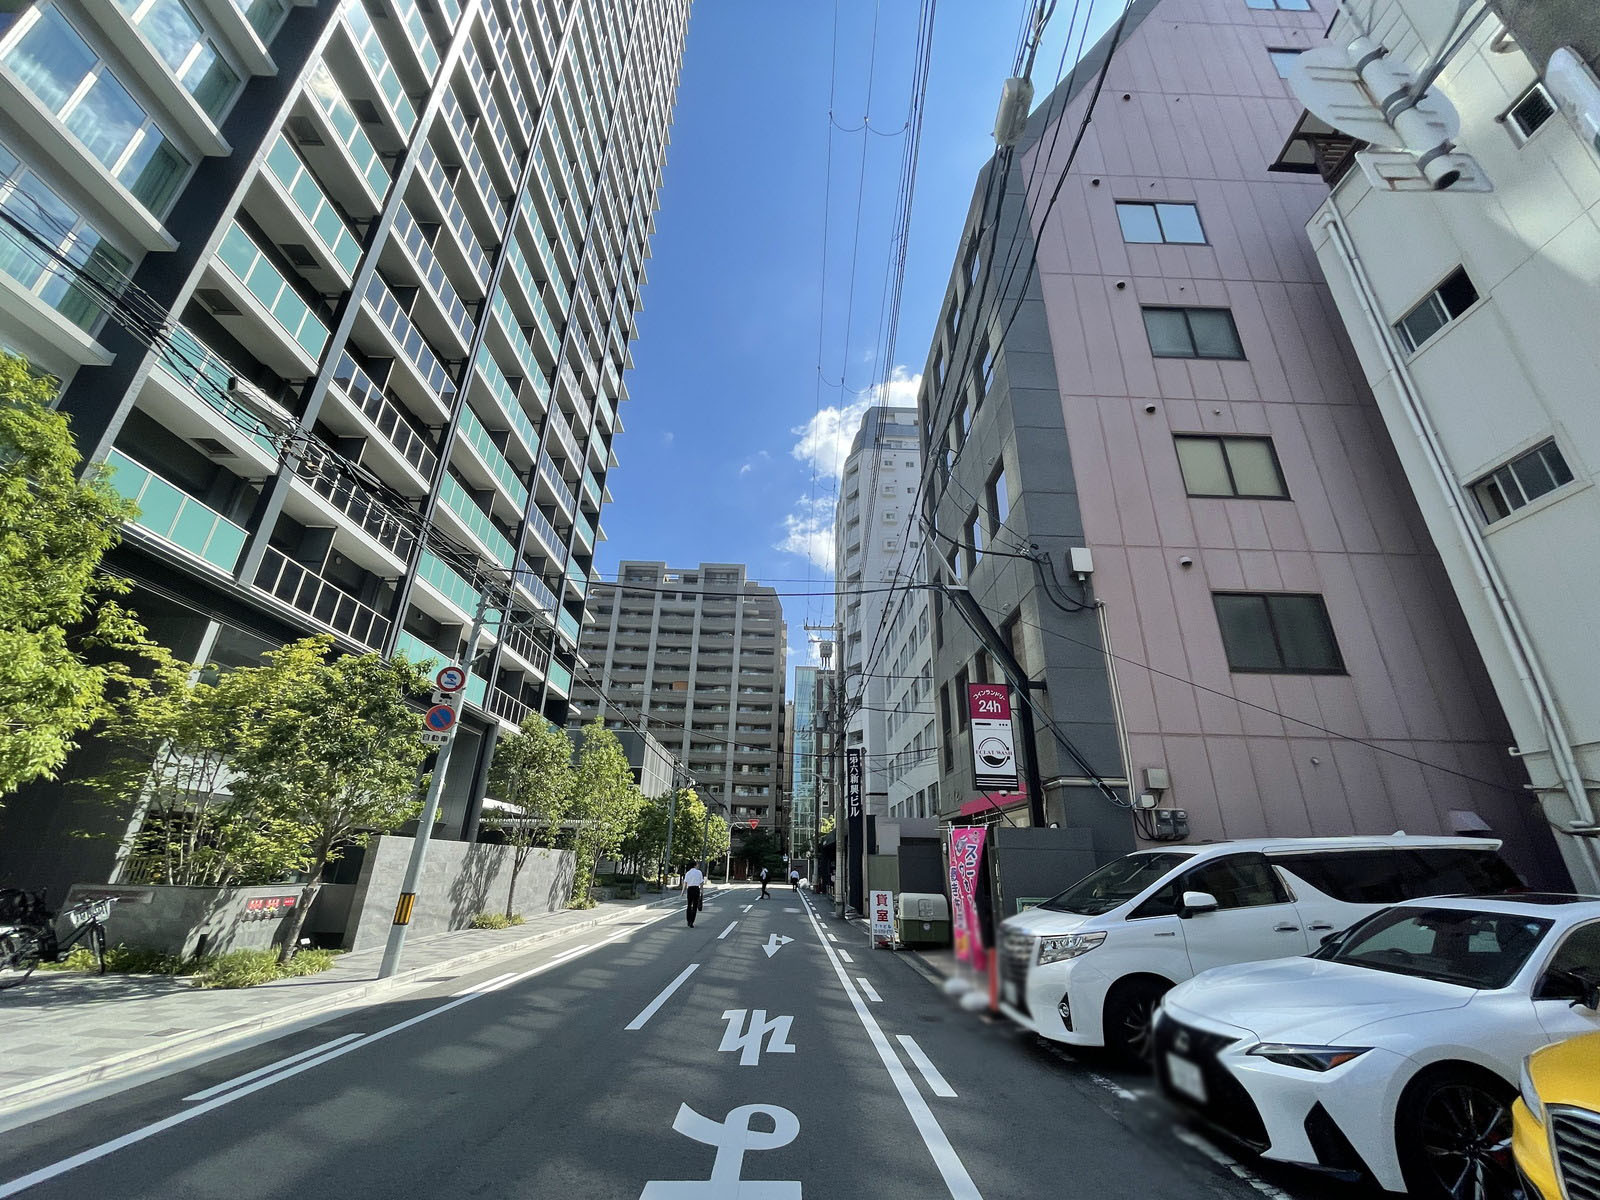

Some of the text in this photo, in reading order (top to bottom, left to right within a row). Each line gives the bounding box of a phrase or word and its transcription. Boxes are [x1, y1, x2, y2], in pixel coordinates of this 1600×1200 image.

[972, 689, 1006, 701] コインランドリー
[978, 699, 1001, 713] 24h
[849, 753, 860, 817] 第六新興ビル
[876, 893, 889, 922] 貸室
